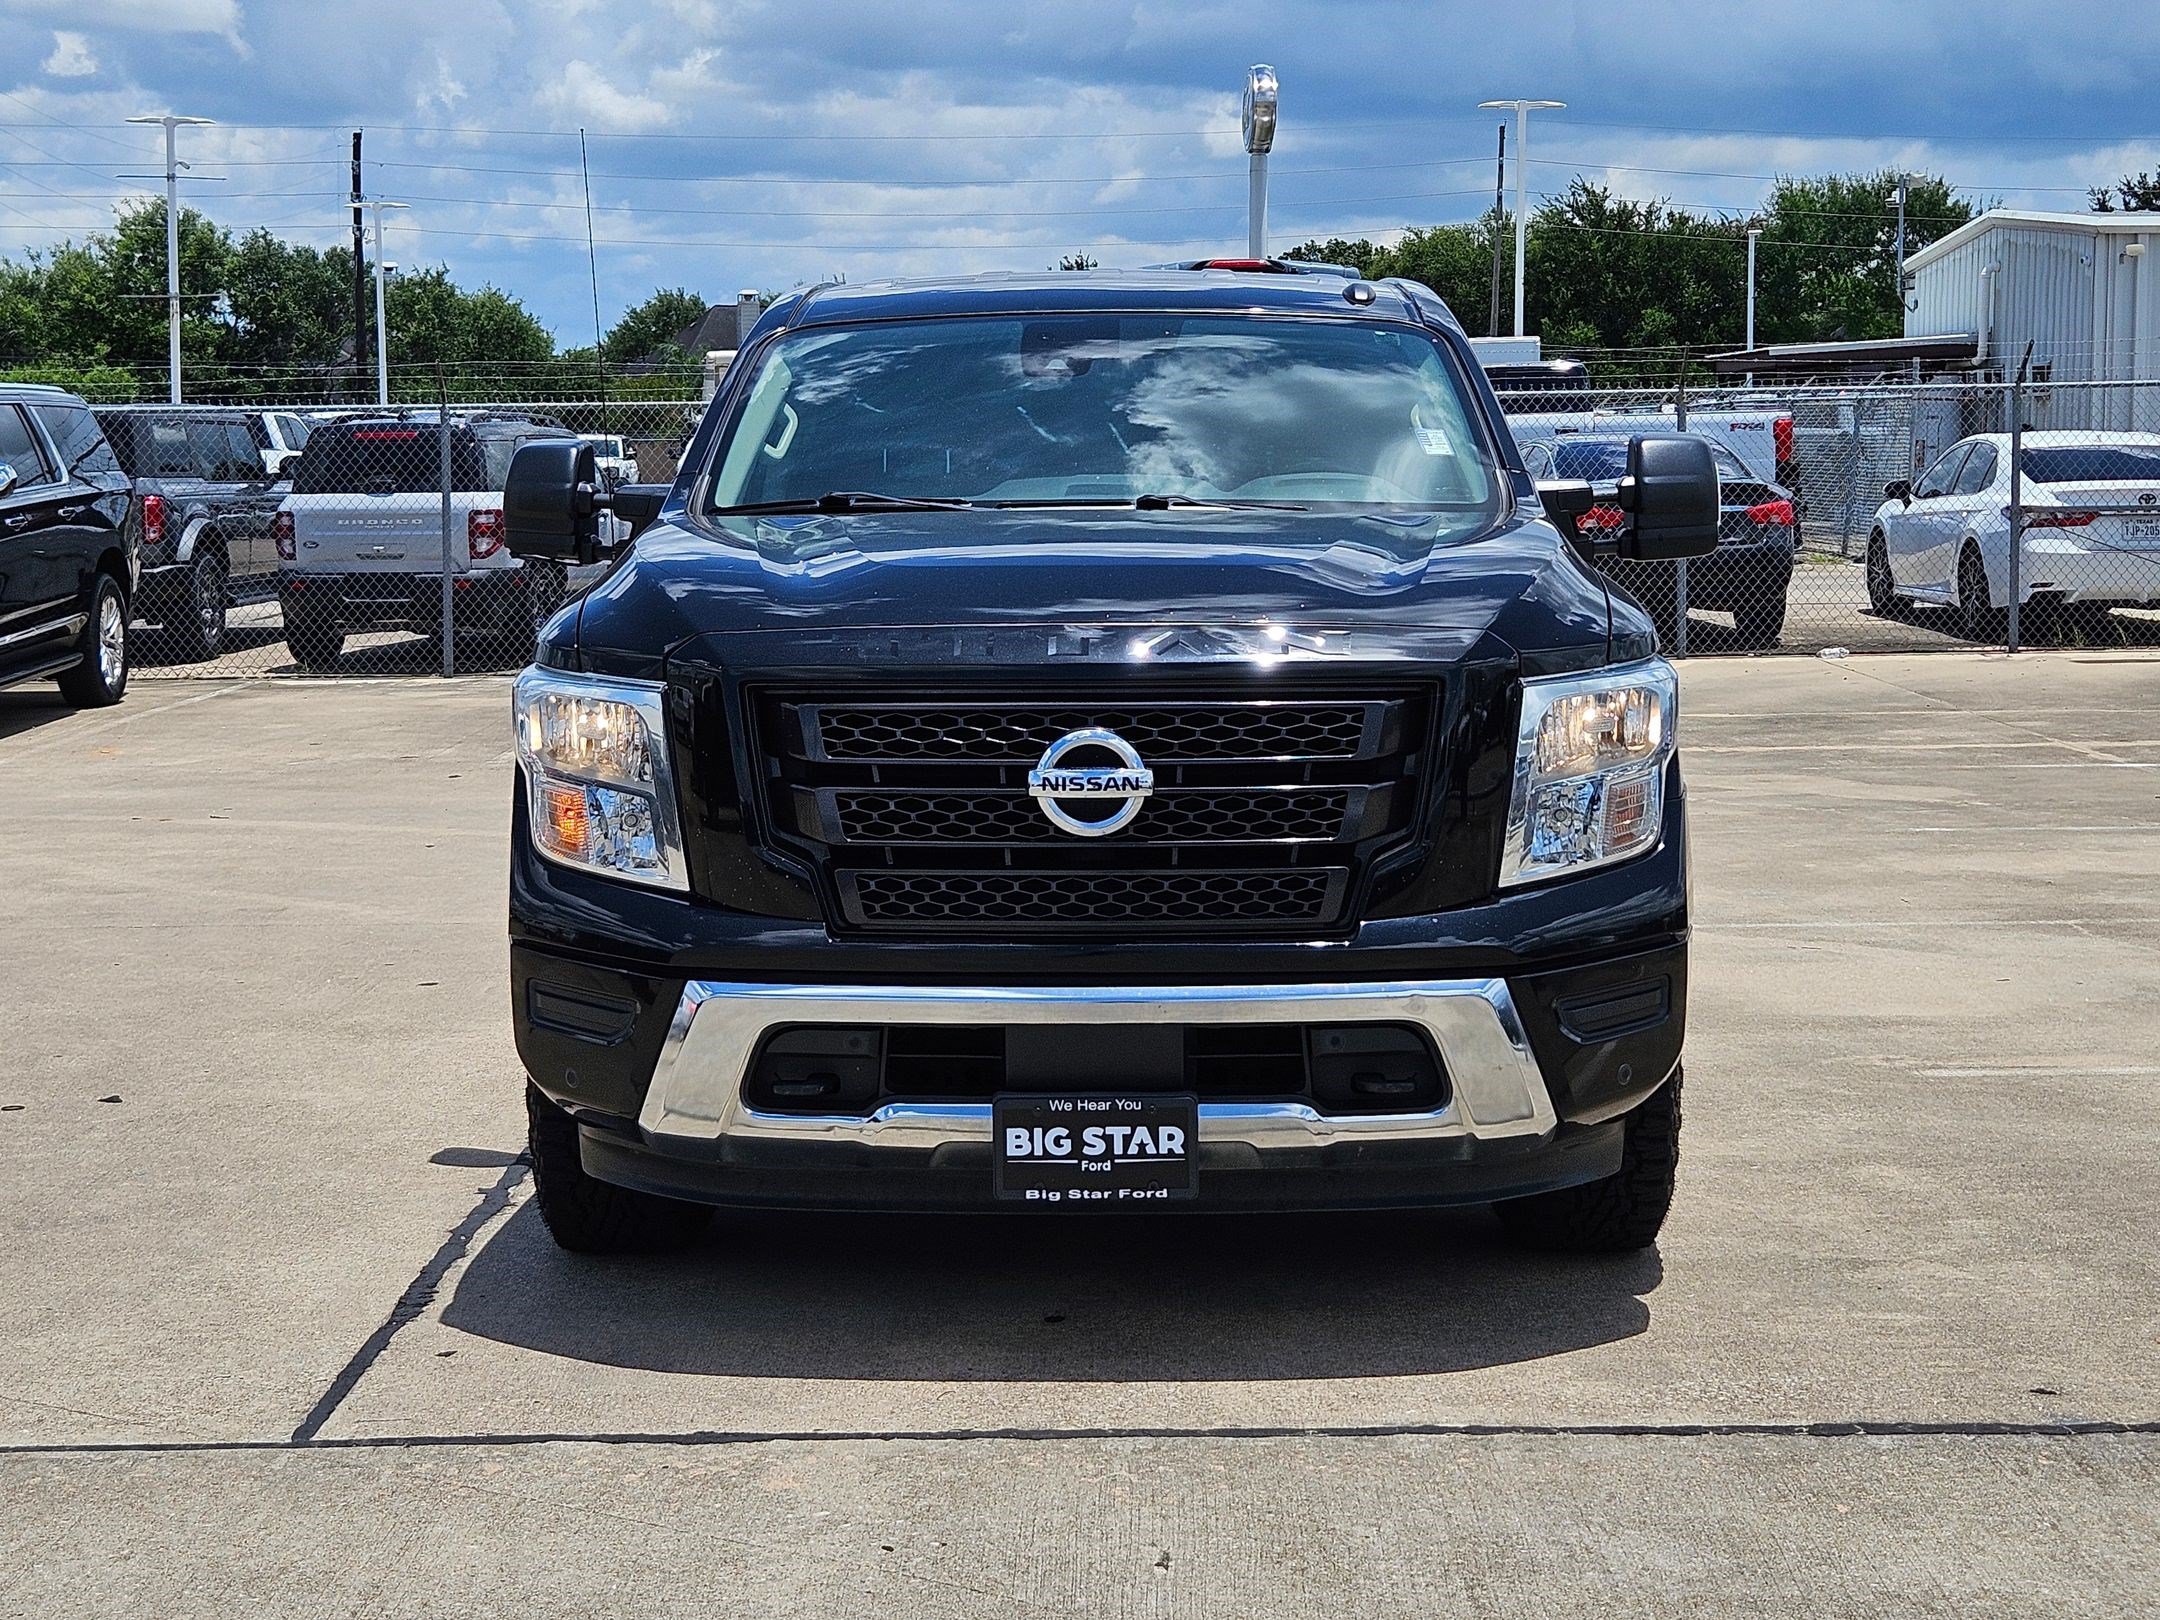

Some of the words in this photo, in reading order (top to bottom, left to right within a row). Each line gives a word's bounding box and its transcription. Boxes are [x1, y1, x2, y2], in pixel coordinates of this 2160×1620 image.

[1041, 776, 1140, 792] NISSAN
[1049, 1100, 1073, 1112] We
[1077, 1099, 1111, 1111] Hear
[1115, 1099, 1142, 1111] You
[1006, 1127, 1072, 1156] BIG
[1082, 1126, 1185, 1156] STAR
[1081, 1160, 1111, 1171] Ford
[1025, 1189, 1061, 1201] Big
[1068, 1188, 1112, 1199] Star
[1118, 1188, 1168, 1199] Ford
